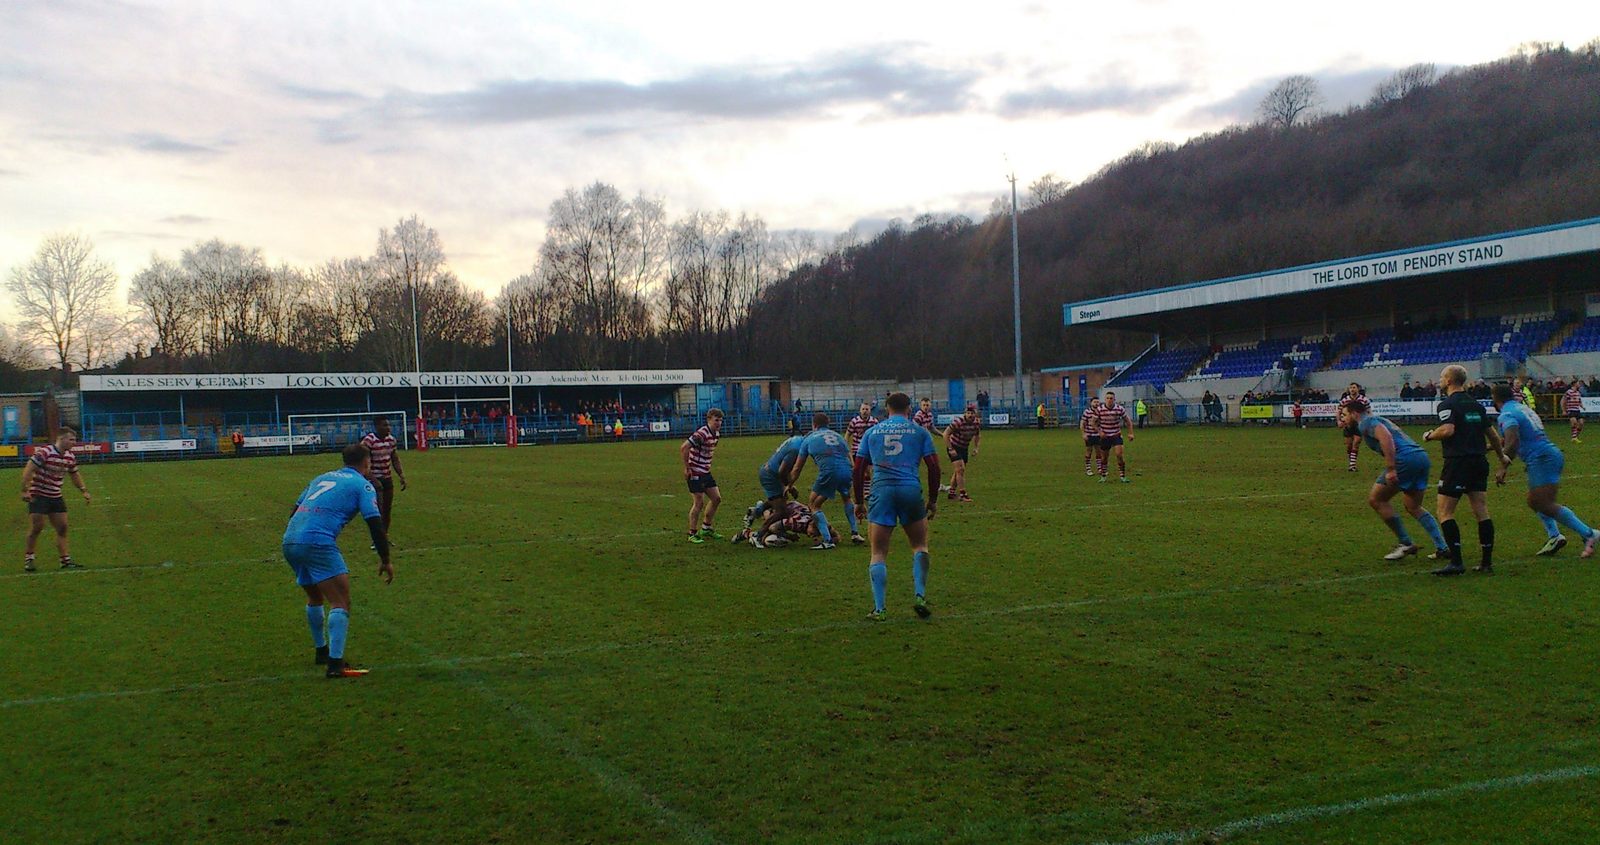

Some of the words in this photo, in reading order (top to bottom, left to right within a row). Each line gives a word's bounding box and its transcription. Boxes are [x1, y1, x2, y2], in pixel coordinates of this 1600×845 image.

[1312, 270, 1334, 284] THE
[1337, 265, 1369, 281] LORD
[1371, 260, 1398, 275] TOM
[1403, 251, 1455, 271] PENDRY
[1458, 244, 1504, 263] STAND
[1079, 310, 1101, 320] Stepan
[107, 377, 154, 387] SALES
[286, 375, 394, 387] LOCKWOOD
[399, 376, 412, 386] &
[418, 374, 532, 386] GREENWOOD
[872, 427, 916, 435] BLACKMORE
[823, 434, 840, 446] 8
[883, 434, 903, 456] 5
[307, 480, 337, 501] 7
